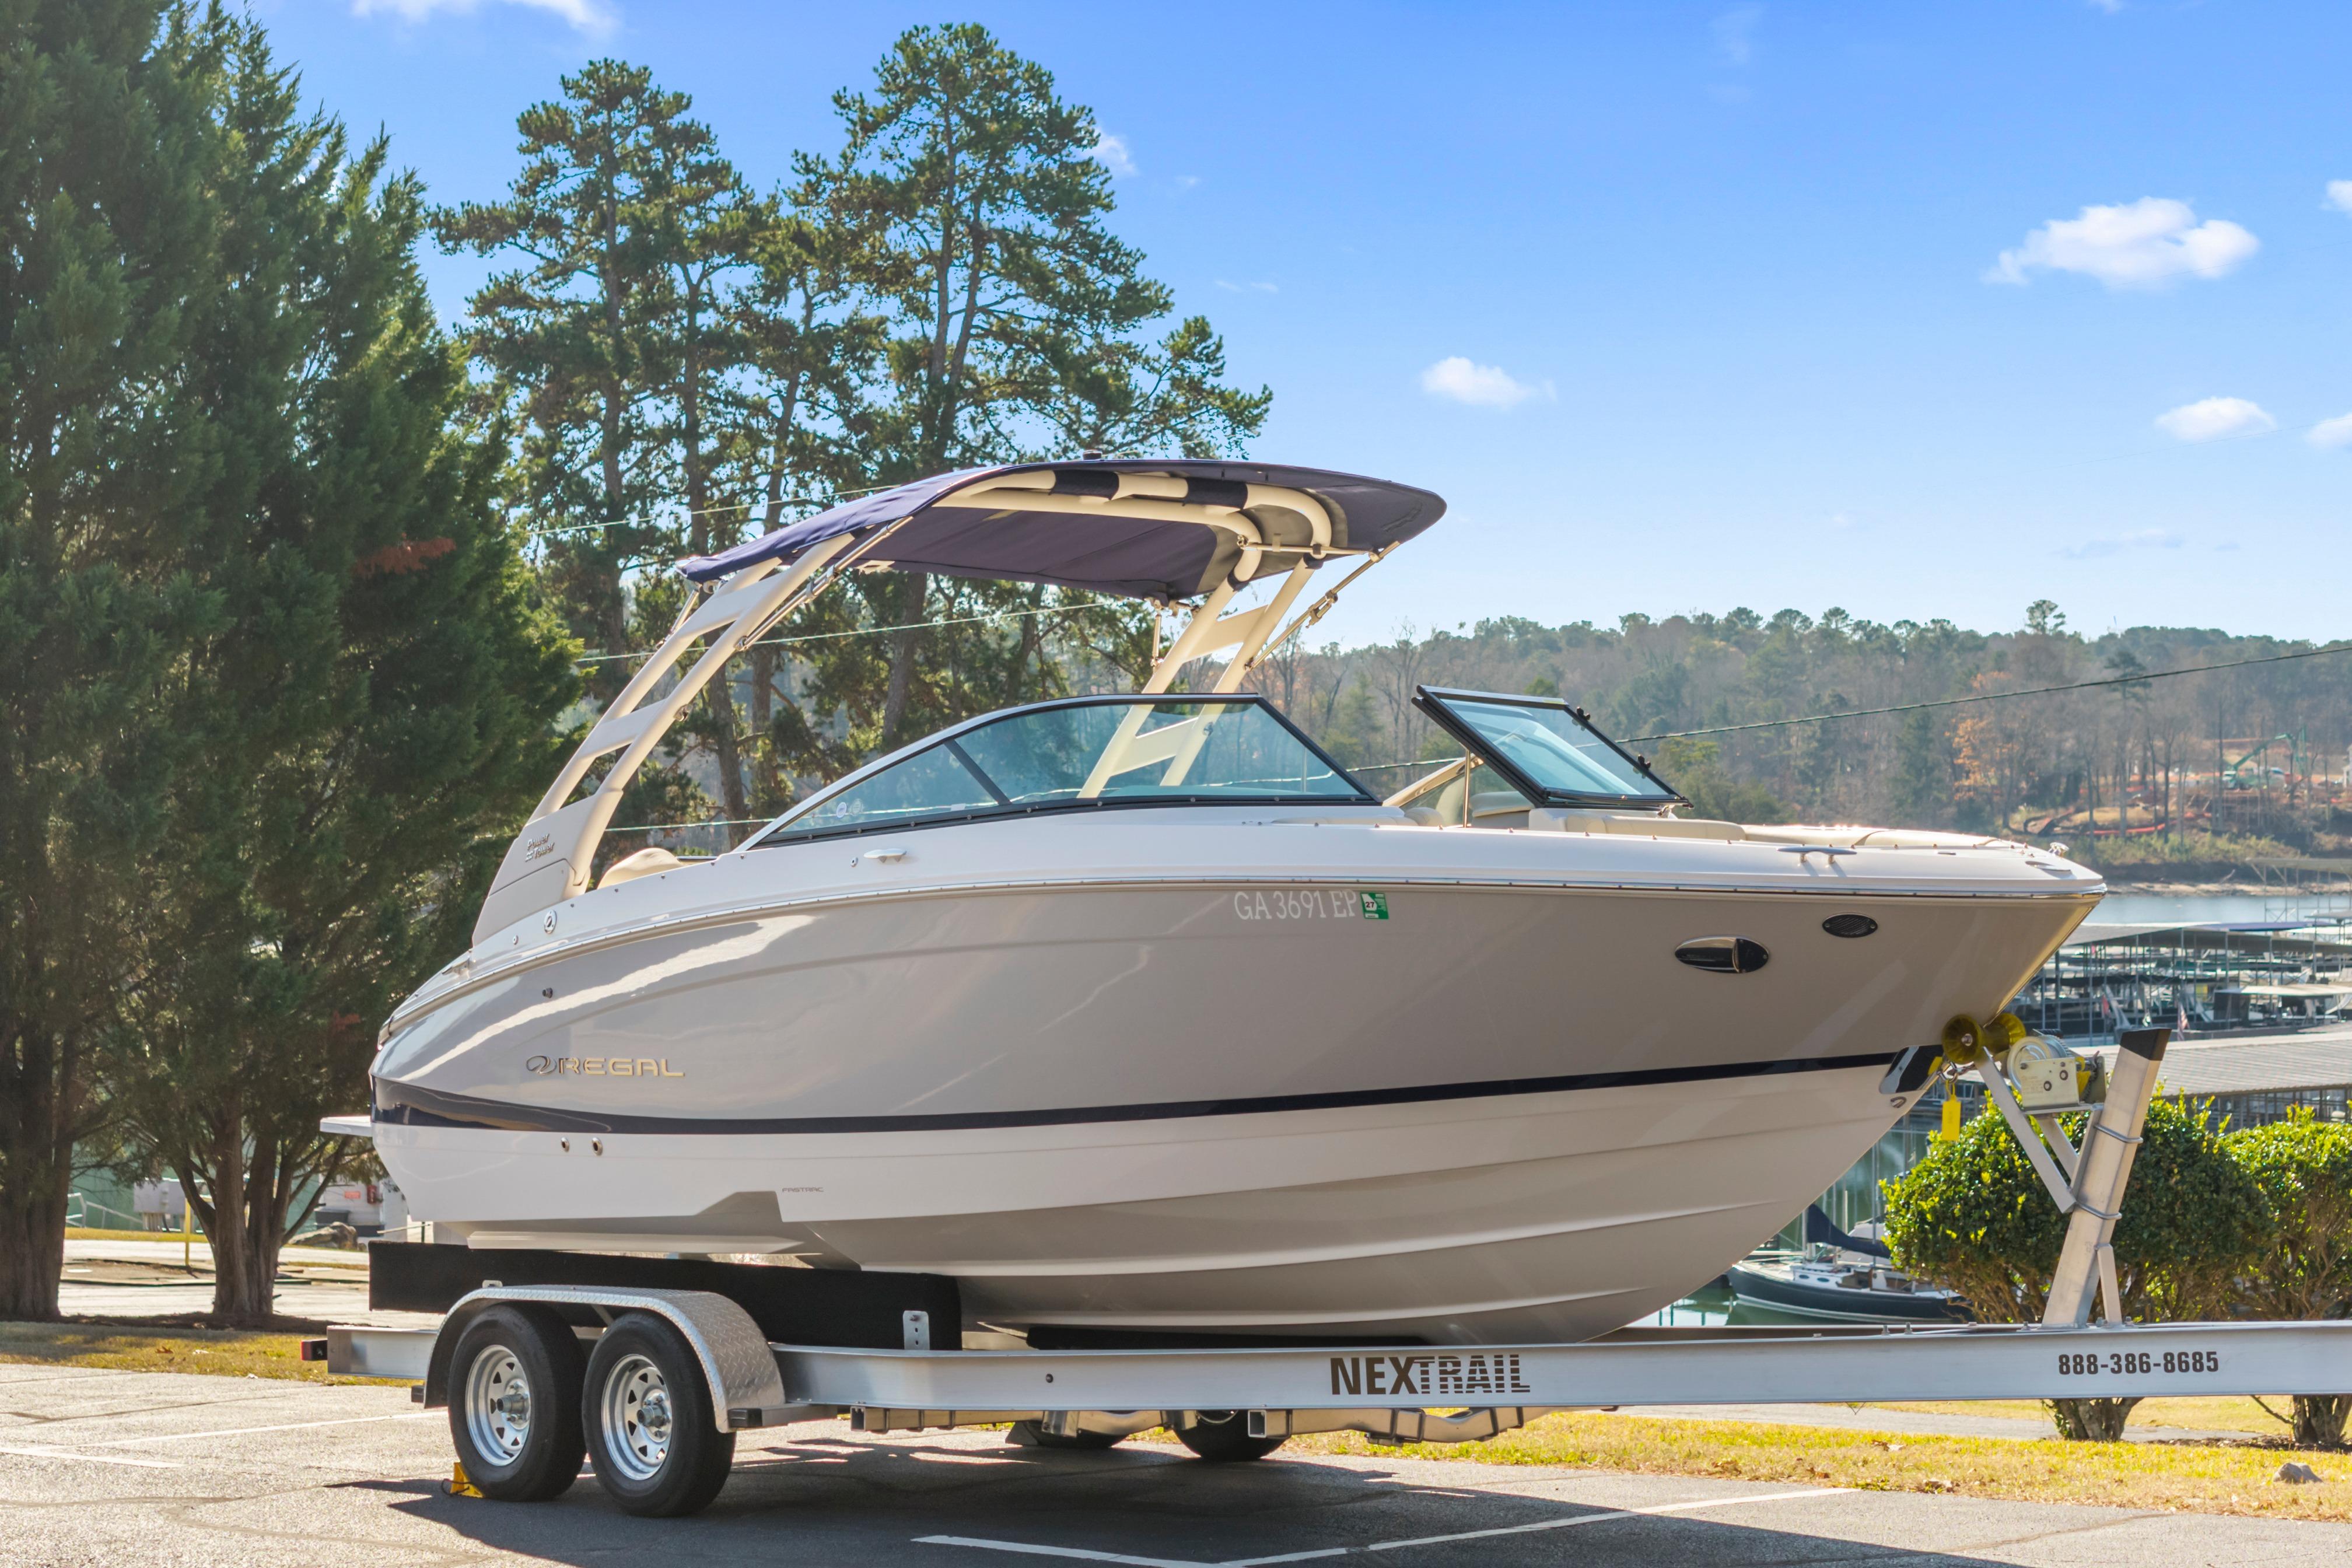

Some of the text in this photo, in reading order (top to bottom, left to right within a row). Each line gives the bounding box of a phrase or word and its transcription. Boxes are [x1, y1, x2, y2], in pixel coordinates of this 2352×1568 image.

[527, 834, 550, 850] Power
[534, 842, 555, 859] Tower
[1234, 891, 1272, 920] GA
[1273, 890, 1326, 919] 3691
[1329, 890, 1357, 918] EP
[559, 1058, 685, 1077] REGAL
[2059, 1351, 2219, 1375] 888-386-8685
[1330, 1354, 1531, 1395] NEXTRAIL
